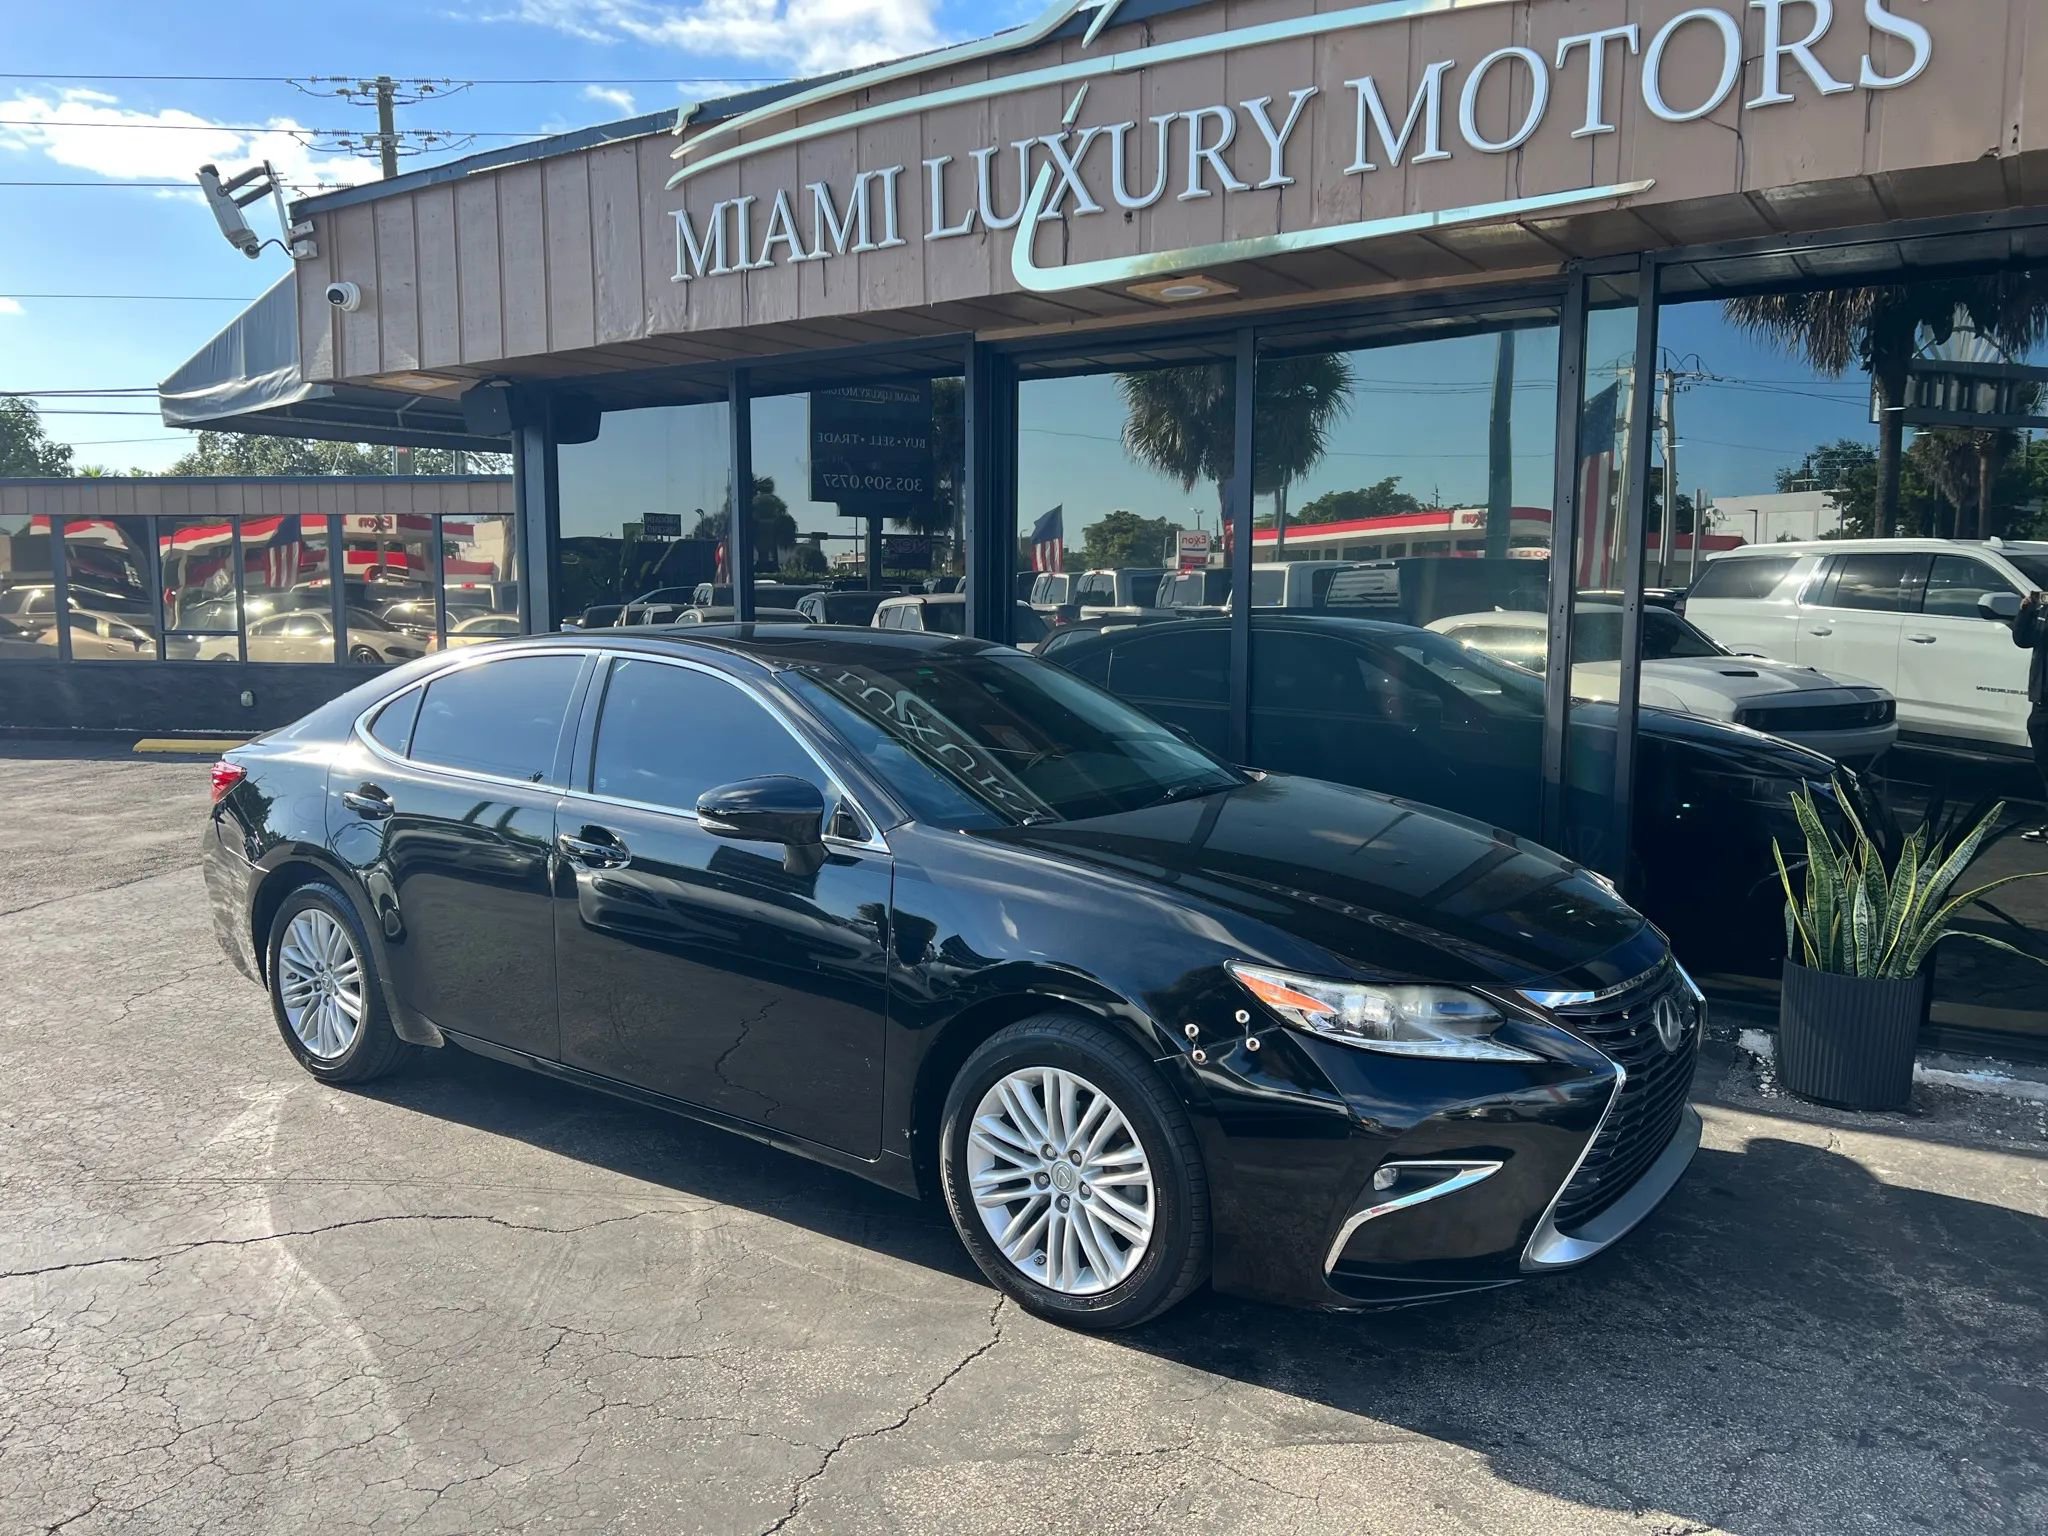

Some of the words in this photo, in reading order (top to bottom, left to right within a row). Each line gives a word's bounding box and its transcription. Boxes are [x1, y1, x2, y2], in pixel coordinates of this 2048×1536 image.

[668, 164, 907, 283] MIAMI
[922, 85, 1320, 242] LUXURY
[1344, 0, 1933, 176] MOTORS
